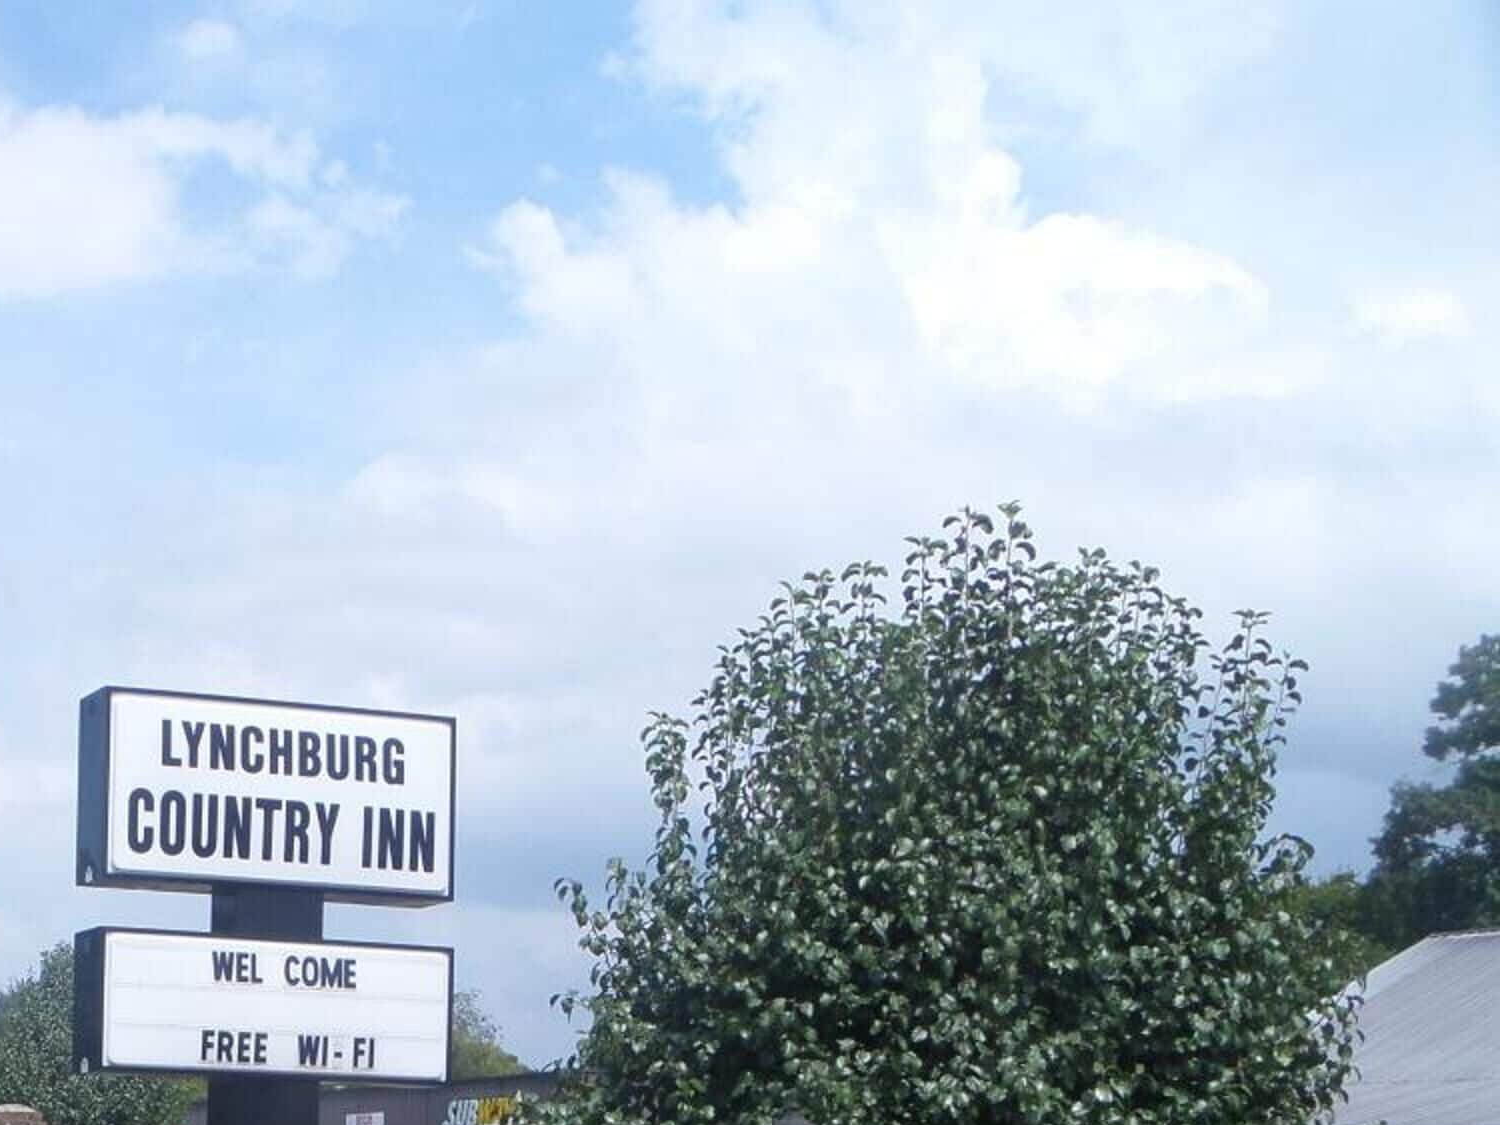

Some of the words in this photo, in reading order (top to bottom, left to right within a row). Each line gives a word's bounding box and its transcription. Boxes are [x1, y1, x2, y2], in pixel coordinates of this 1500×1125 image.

[160, 718, 406, 785] LYNCHBURG
[127, 787, 341, 866] COUNTRY
[361, 806, 436, 873] INN
[200, 1028, 269, 1065] FREE
